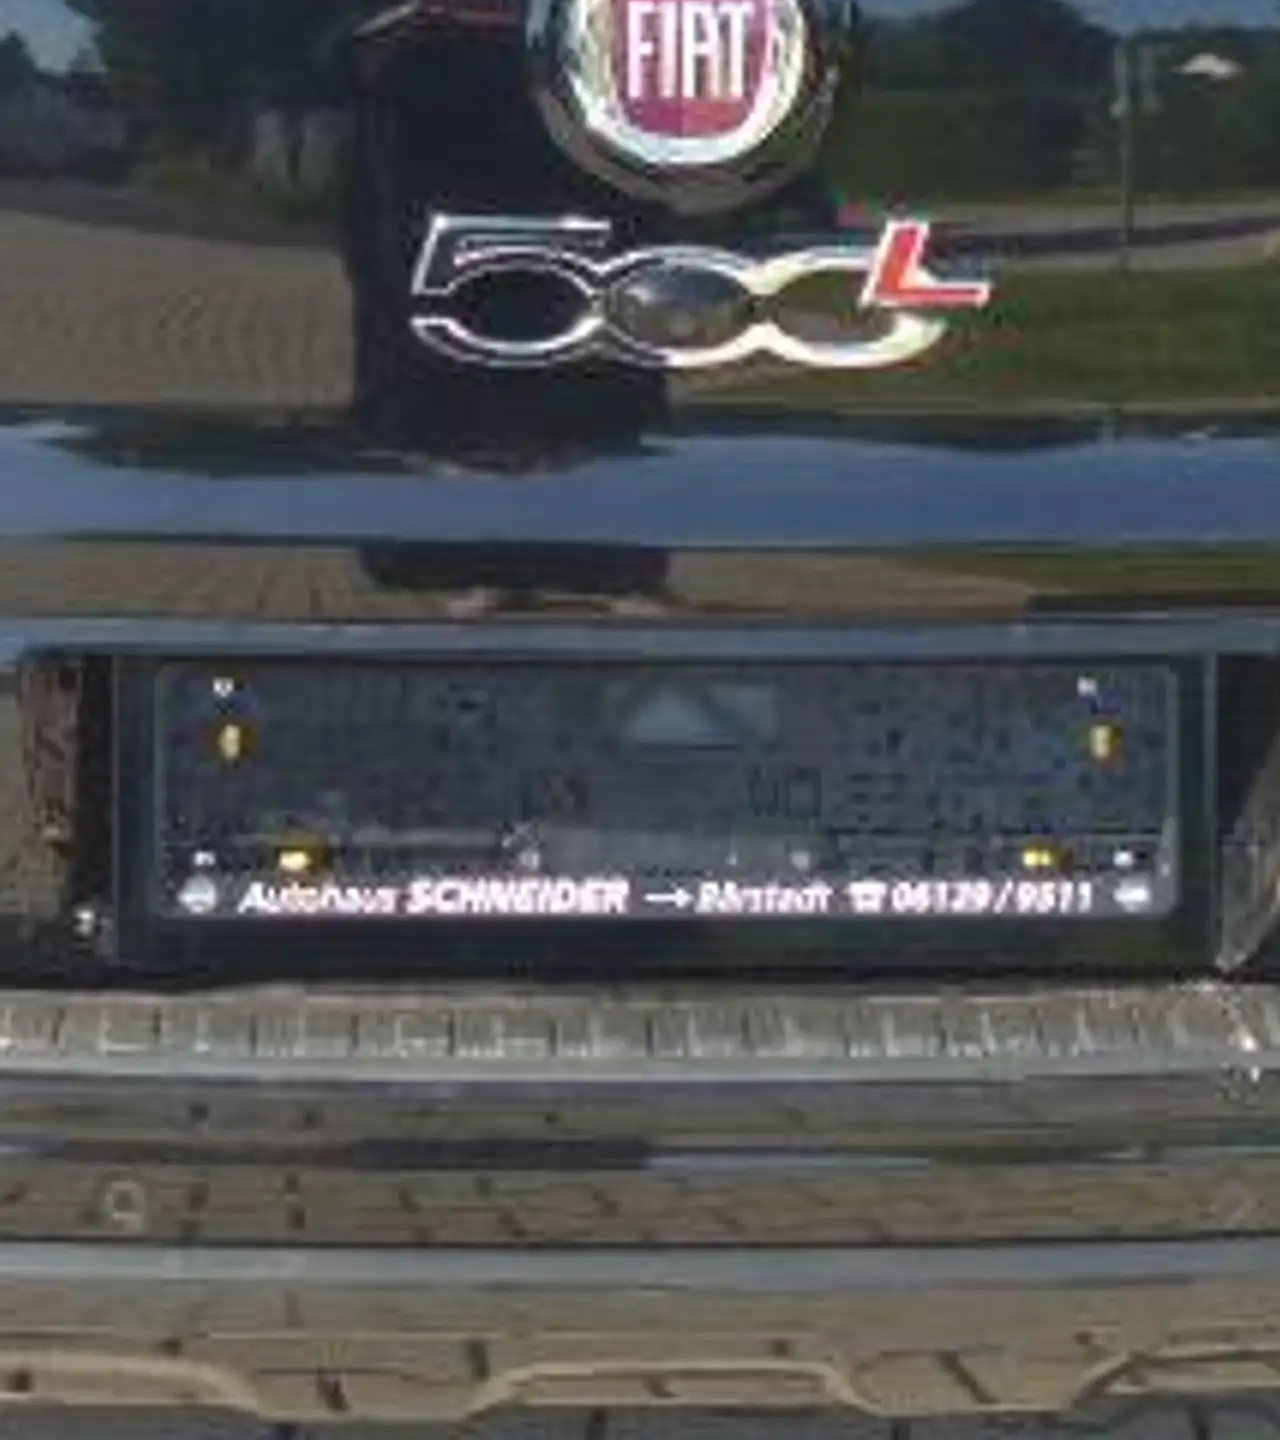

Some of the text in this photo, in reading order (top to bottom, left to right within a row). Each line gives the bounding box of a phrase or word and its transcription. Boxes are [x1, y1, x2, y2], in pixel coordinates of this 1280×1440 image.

[626, 0, 756, 98] FIAT
[411, 213, 993, 368] 500L
[237, 880, 398, 914] Autohaus
[406, 877, 630, 915] SCHNEIDER
